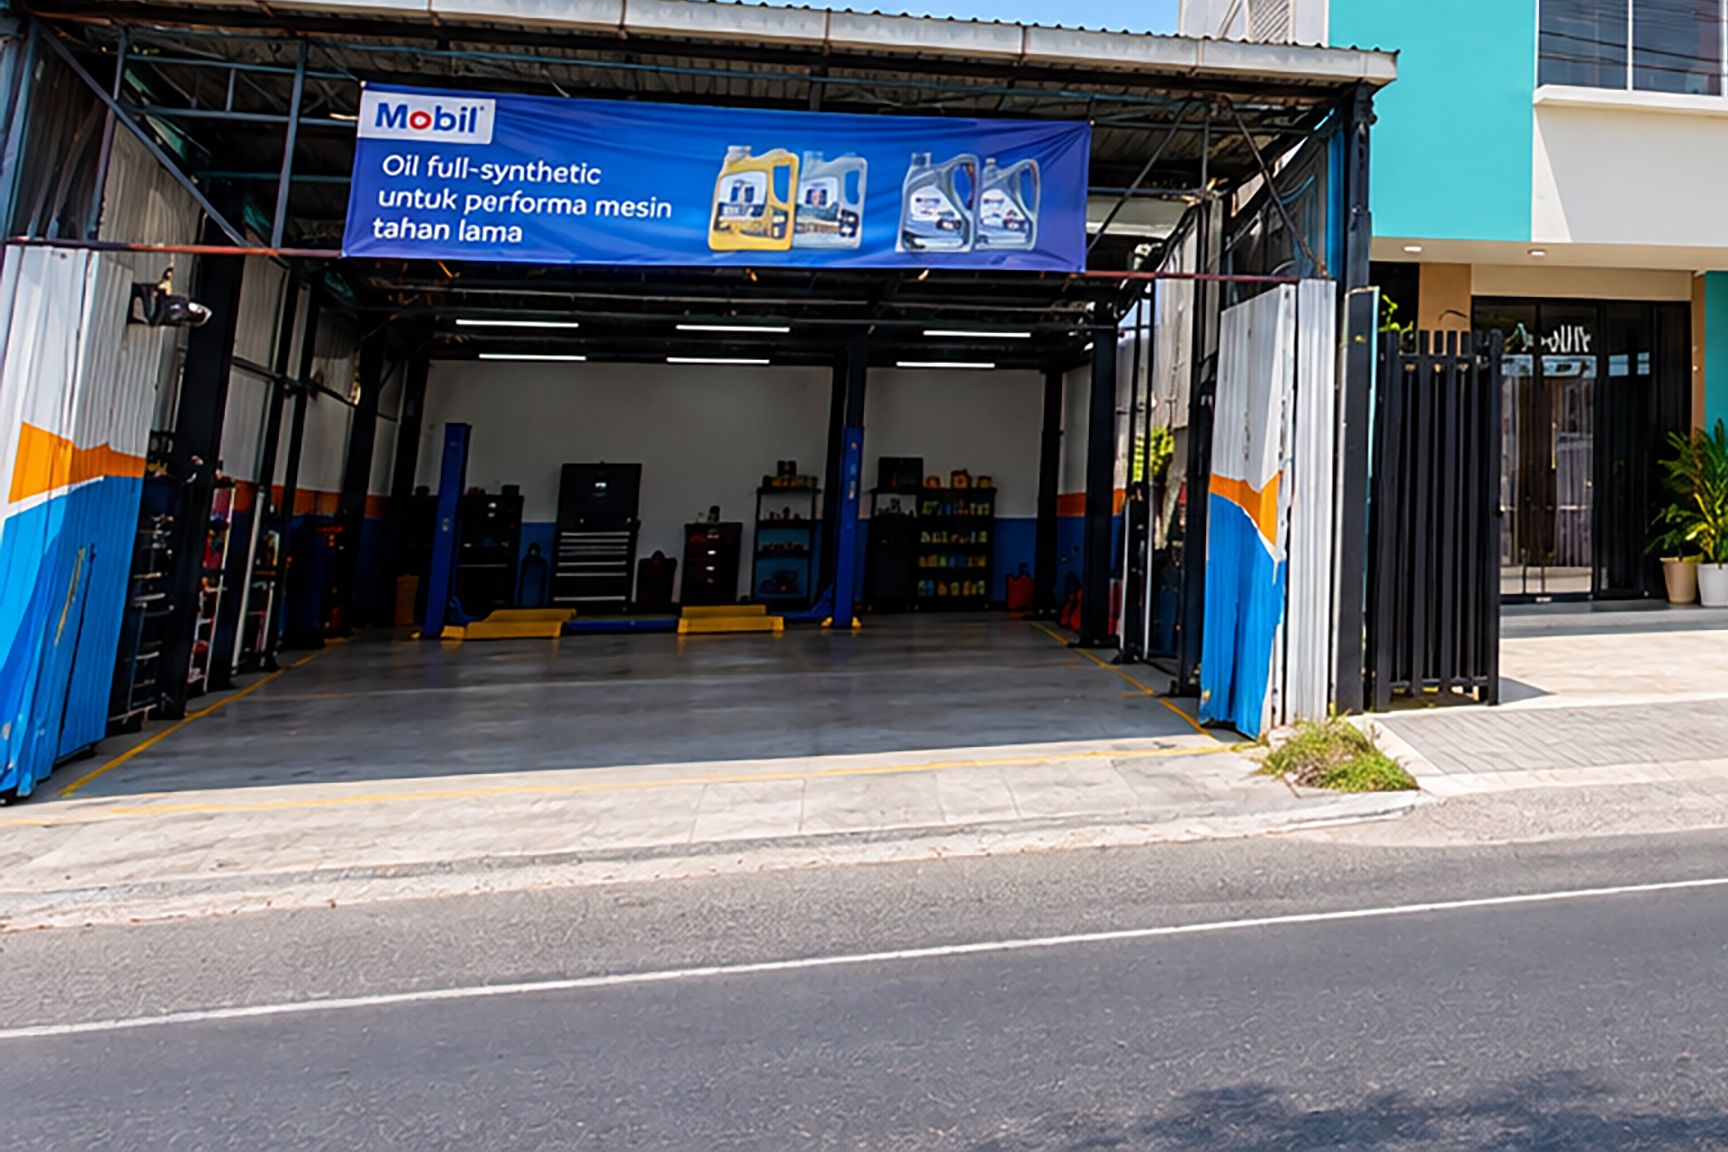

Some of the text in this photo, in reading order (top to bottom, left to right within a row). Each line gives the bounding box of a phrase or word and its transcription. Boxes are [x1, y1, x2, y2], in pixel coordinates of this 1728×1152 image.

[374, 102, 478, 134] Mobil
[382, 154, 602, 186] Oil full-synthetic
[378, 187, 673, 219] untuk performa mesin
[372, 217, 523, 244] tahan lama
